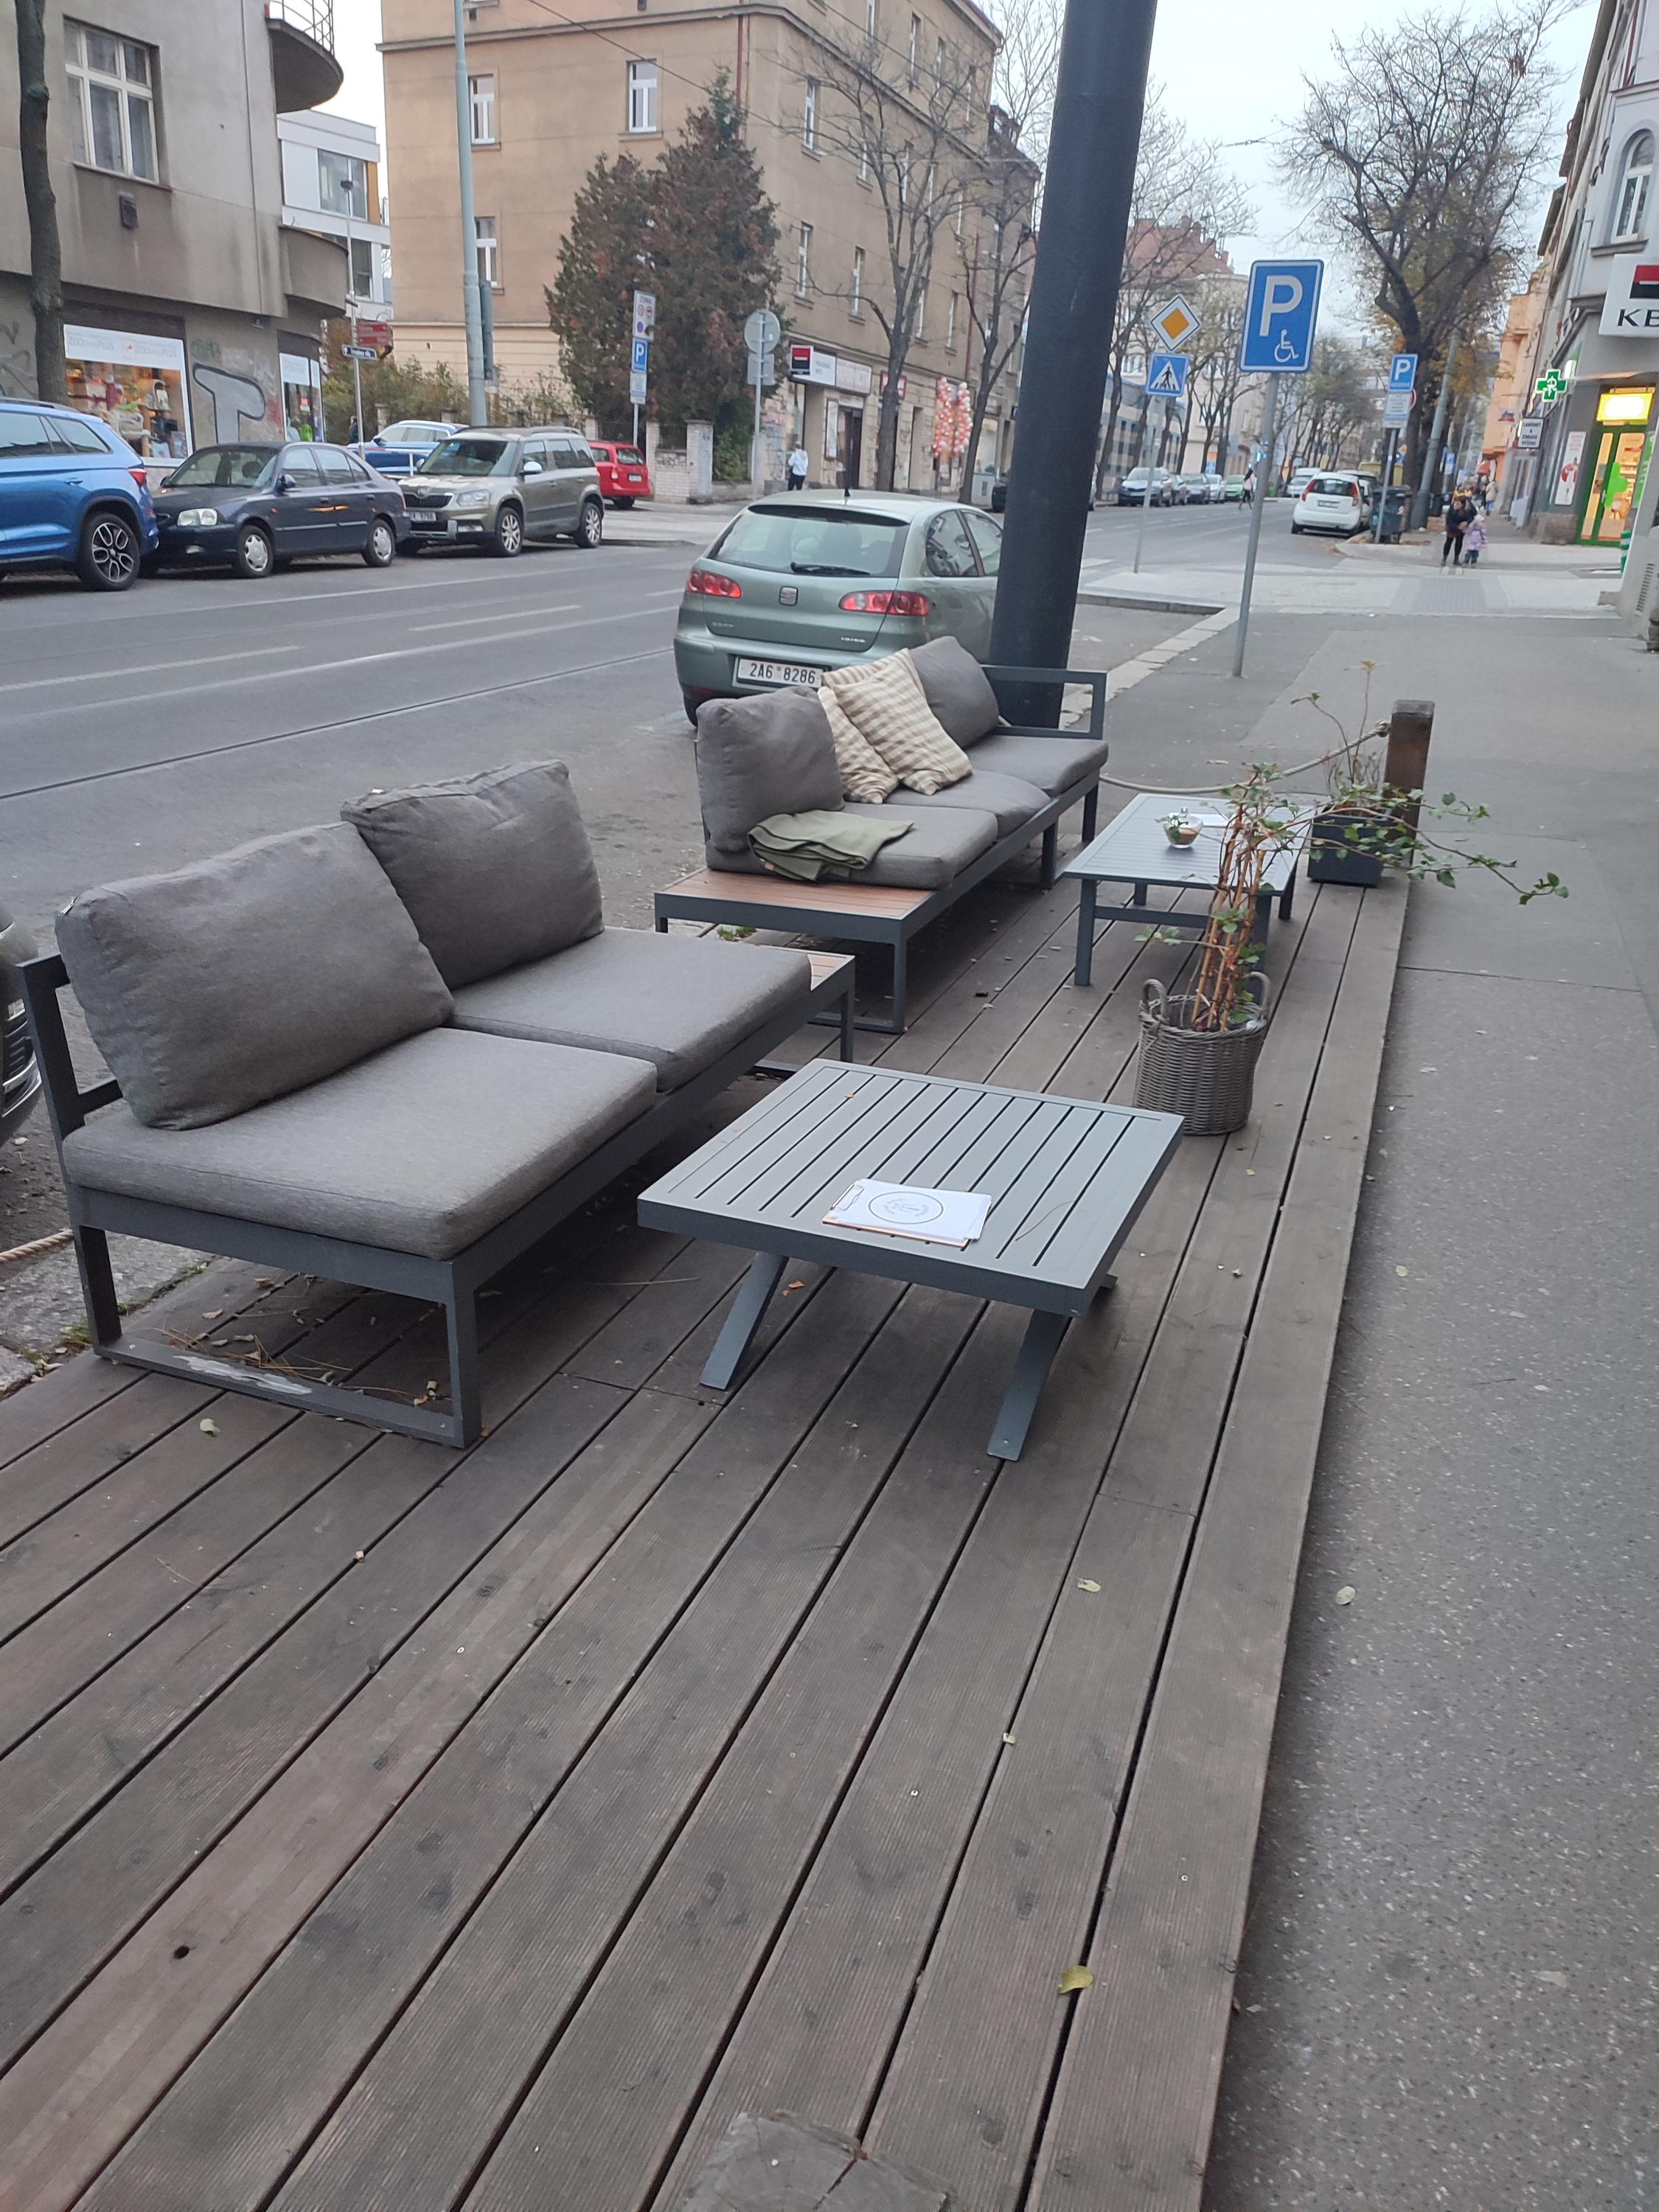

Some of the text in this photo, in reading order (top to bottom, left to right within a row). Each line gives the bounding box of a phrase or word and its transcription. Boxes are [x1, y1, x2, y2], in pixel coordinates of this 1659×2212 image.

[1259, 275, 1303, 337] P
[635, 343, 644, 363] P
[1394, 359, 1411, 380] P
[748, 662, 816, 684] 2A6 8286
